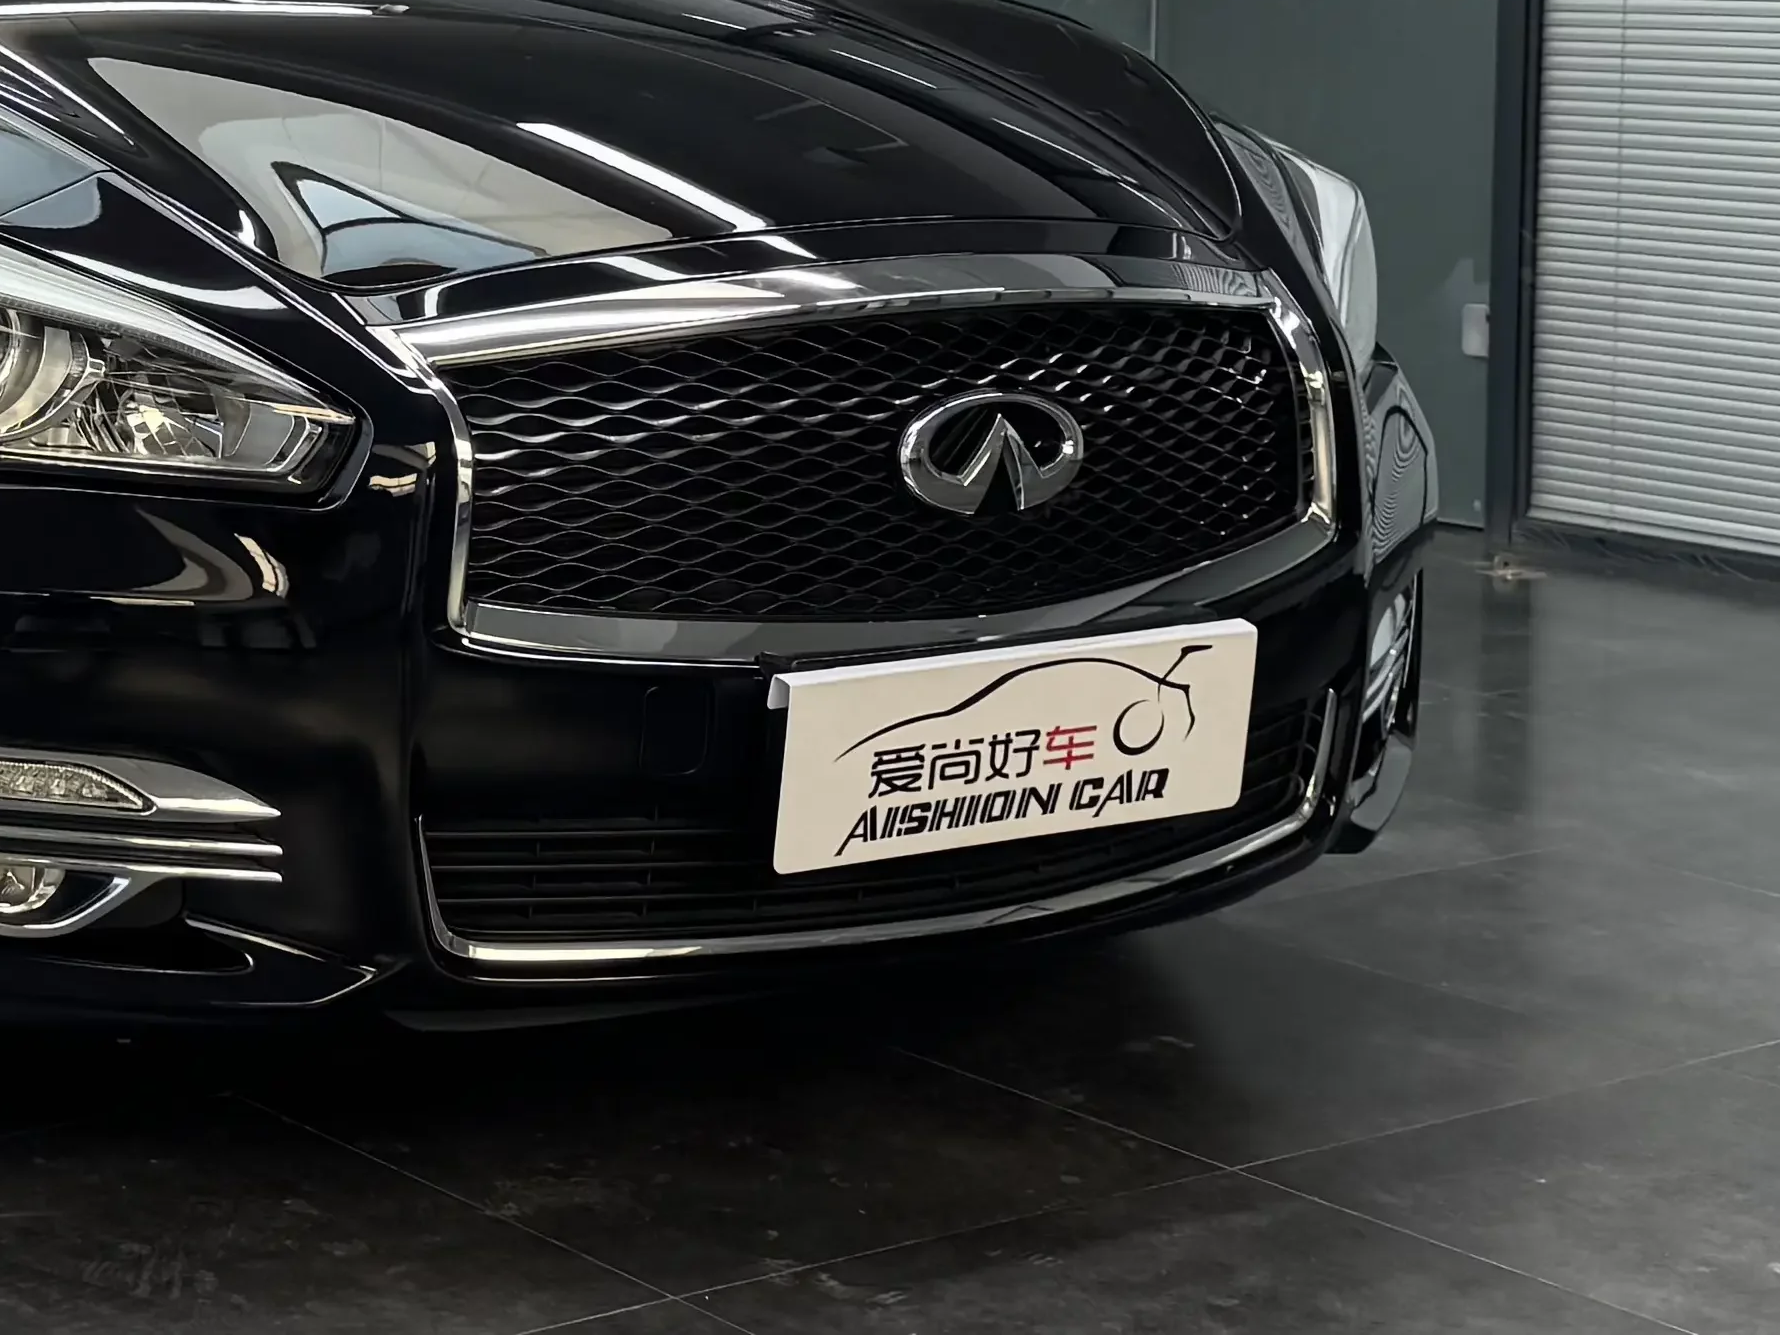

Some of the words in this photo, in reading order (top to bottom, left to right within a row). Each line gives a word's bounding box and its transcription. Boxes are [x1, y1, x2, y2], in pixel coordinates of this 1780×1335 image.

[867, 725, 1097, 799] 爱尚好车
[834, 783, 1061, 857] AISHION
[1069, 768, 1170, 818] CAR
